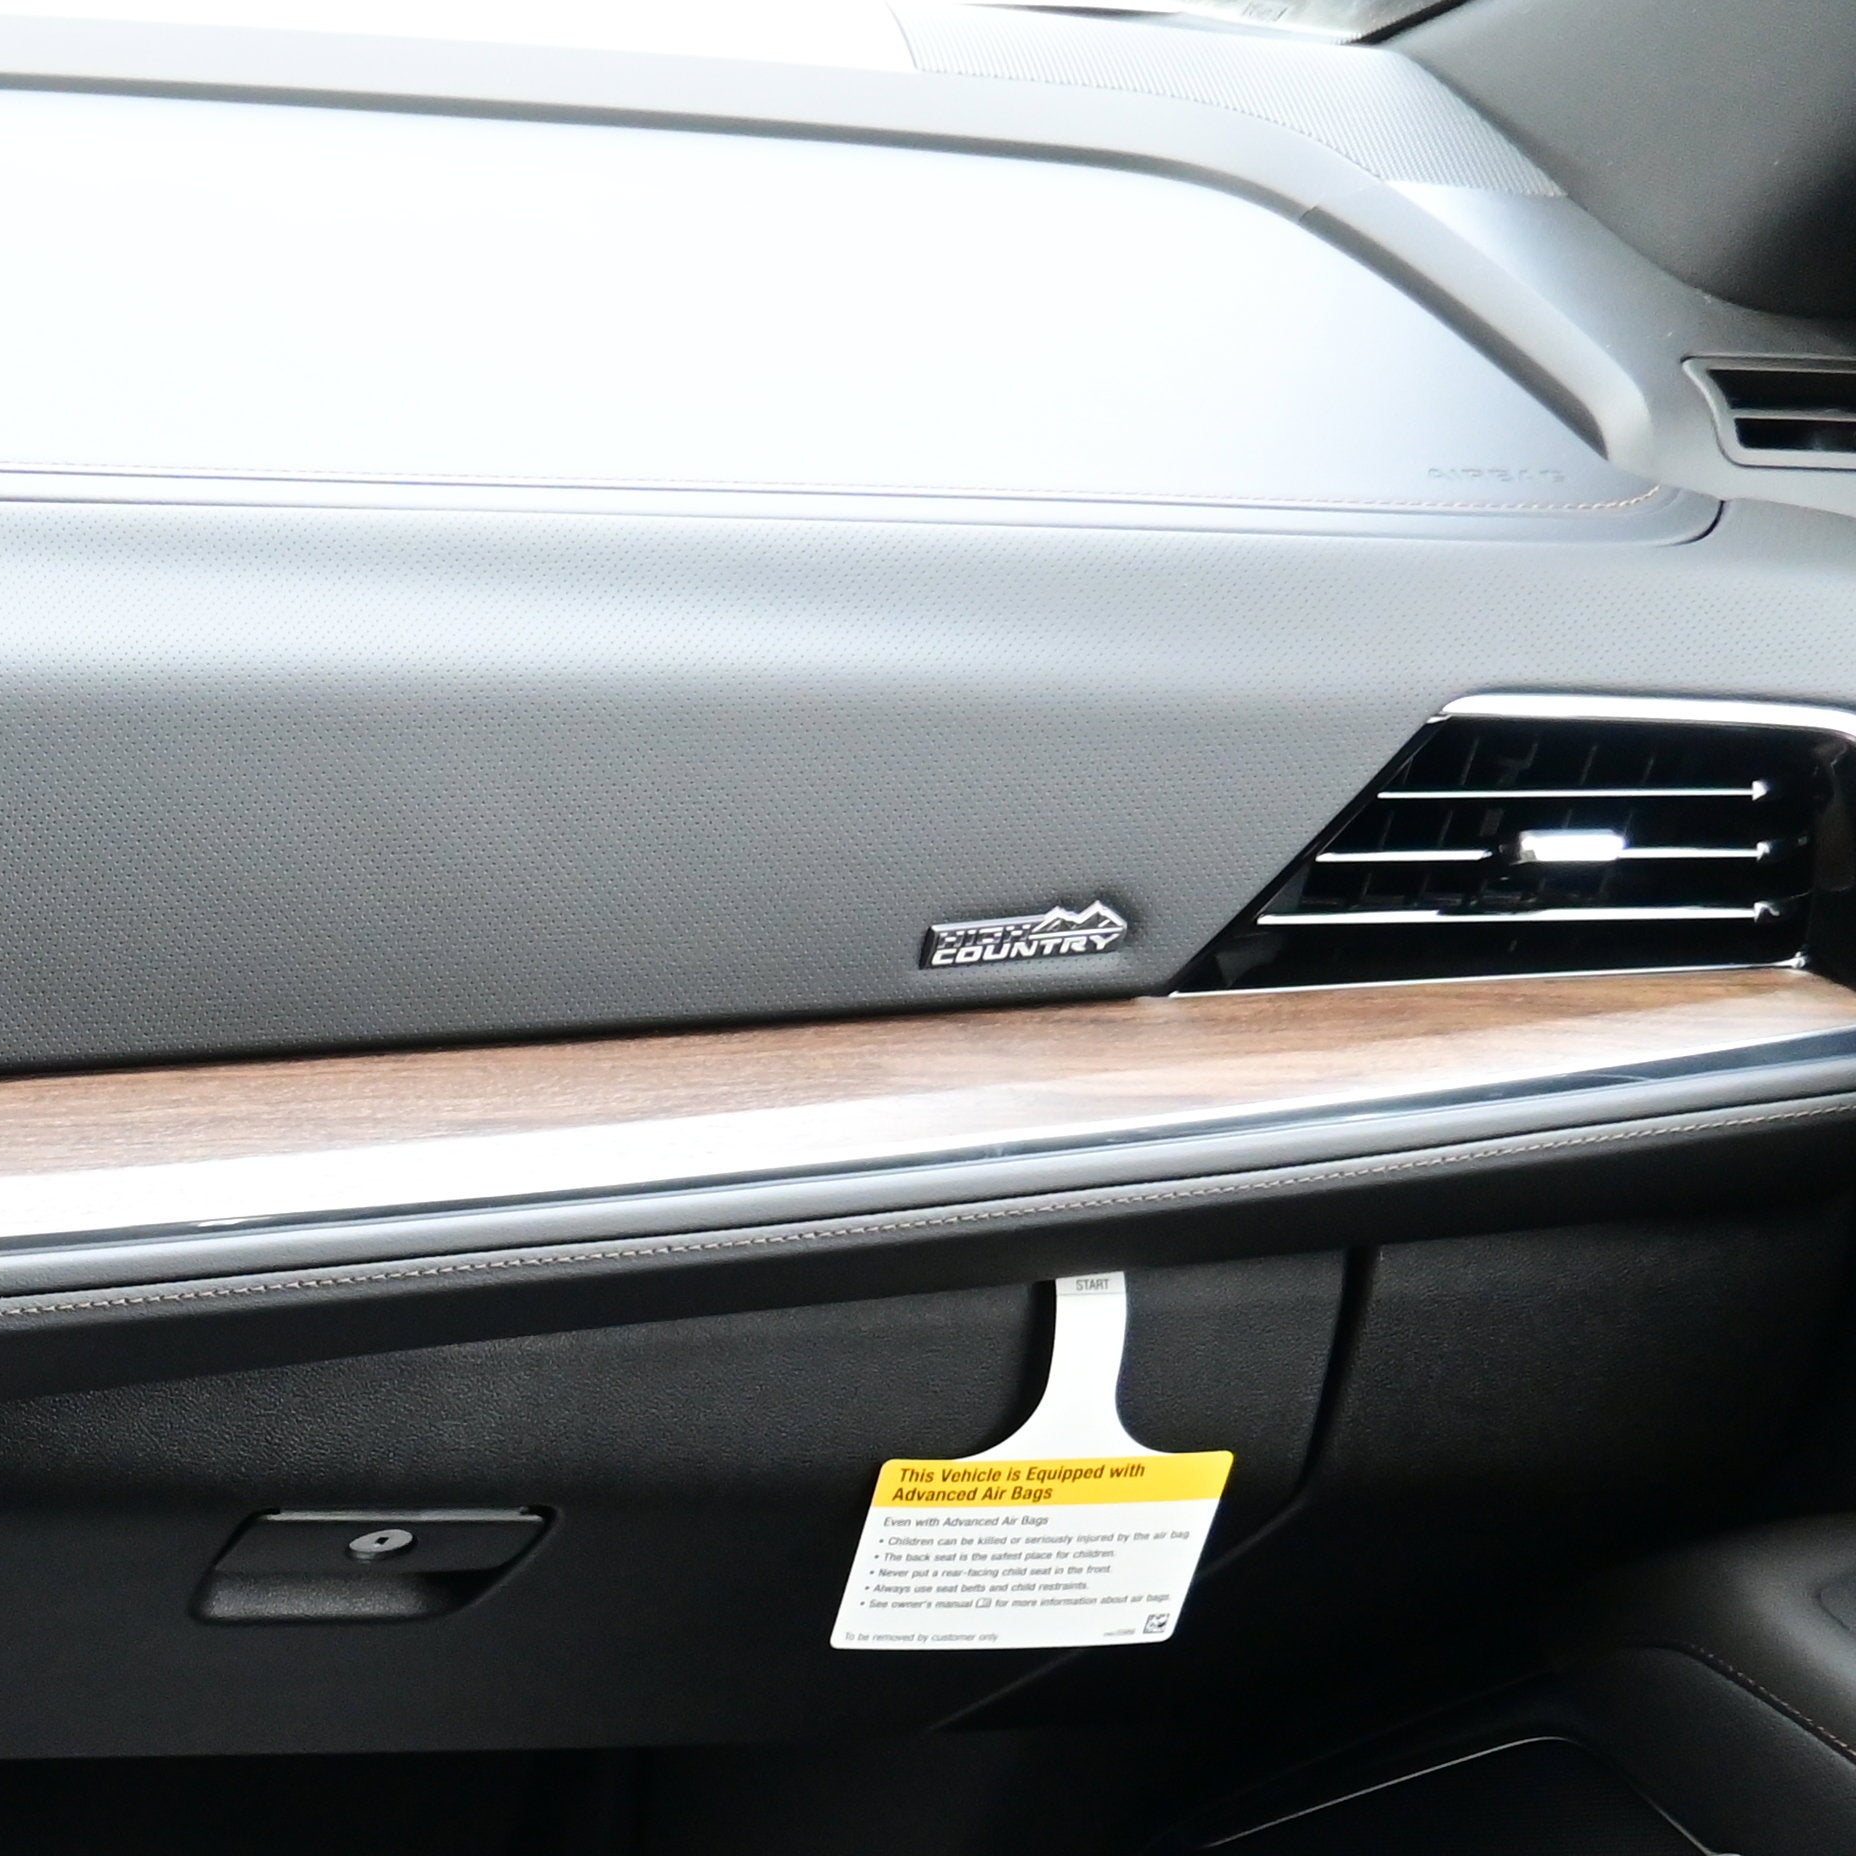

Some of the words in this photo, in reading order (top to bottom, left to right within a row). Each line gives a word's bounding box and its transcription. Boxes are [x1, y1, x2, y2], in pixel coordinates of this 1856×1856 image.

[931, 933, 1121, 966] COUNTRY
[1076, 1279, 1109, 1291] START
[900, 1468, 934, 1483] This
[941, 1467, 1001, 1482] Vehicle
[1006, 1466, 1020, 1481] is
[1026, 1464, 1105, 1484] Equipped
[1109, 1463, 1145, 1478] with
[892, 1486, 978, 1501] Advanced
[982, 1486, 1006, 1500] Air
[1011, 1486, 1053, 1502] Bags
[883, 1516, 911, 1527] Even
[915, 1516, 939, 1527] with
[943, 1516, 999, 1527] Advanced
[1002, 1515, 1018, 1526] Air
[1021, 1515, 1048, 1528] Bags
